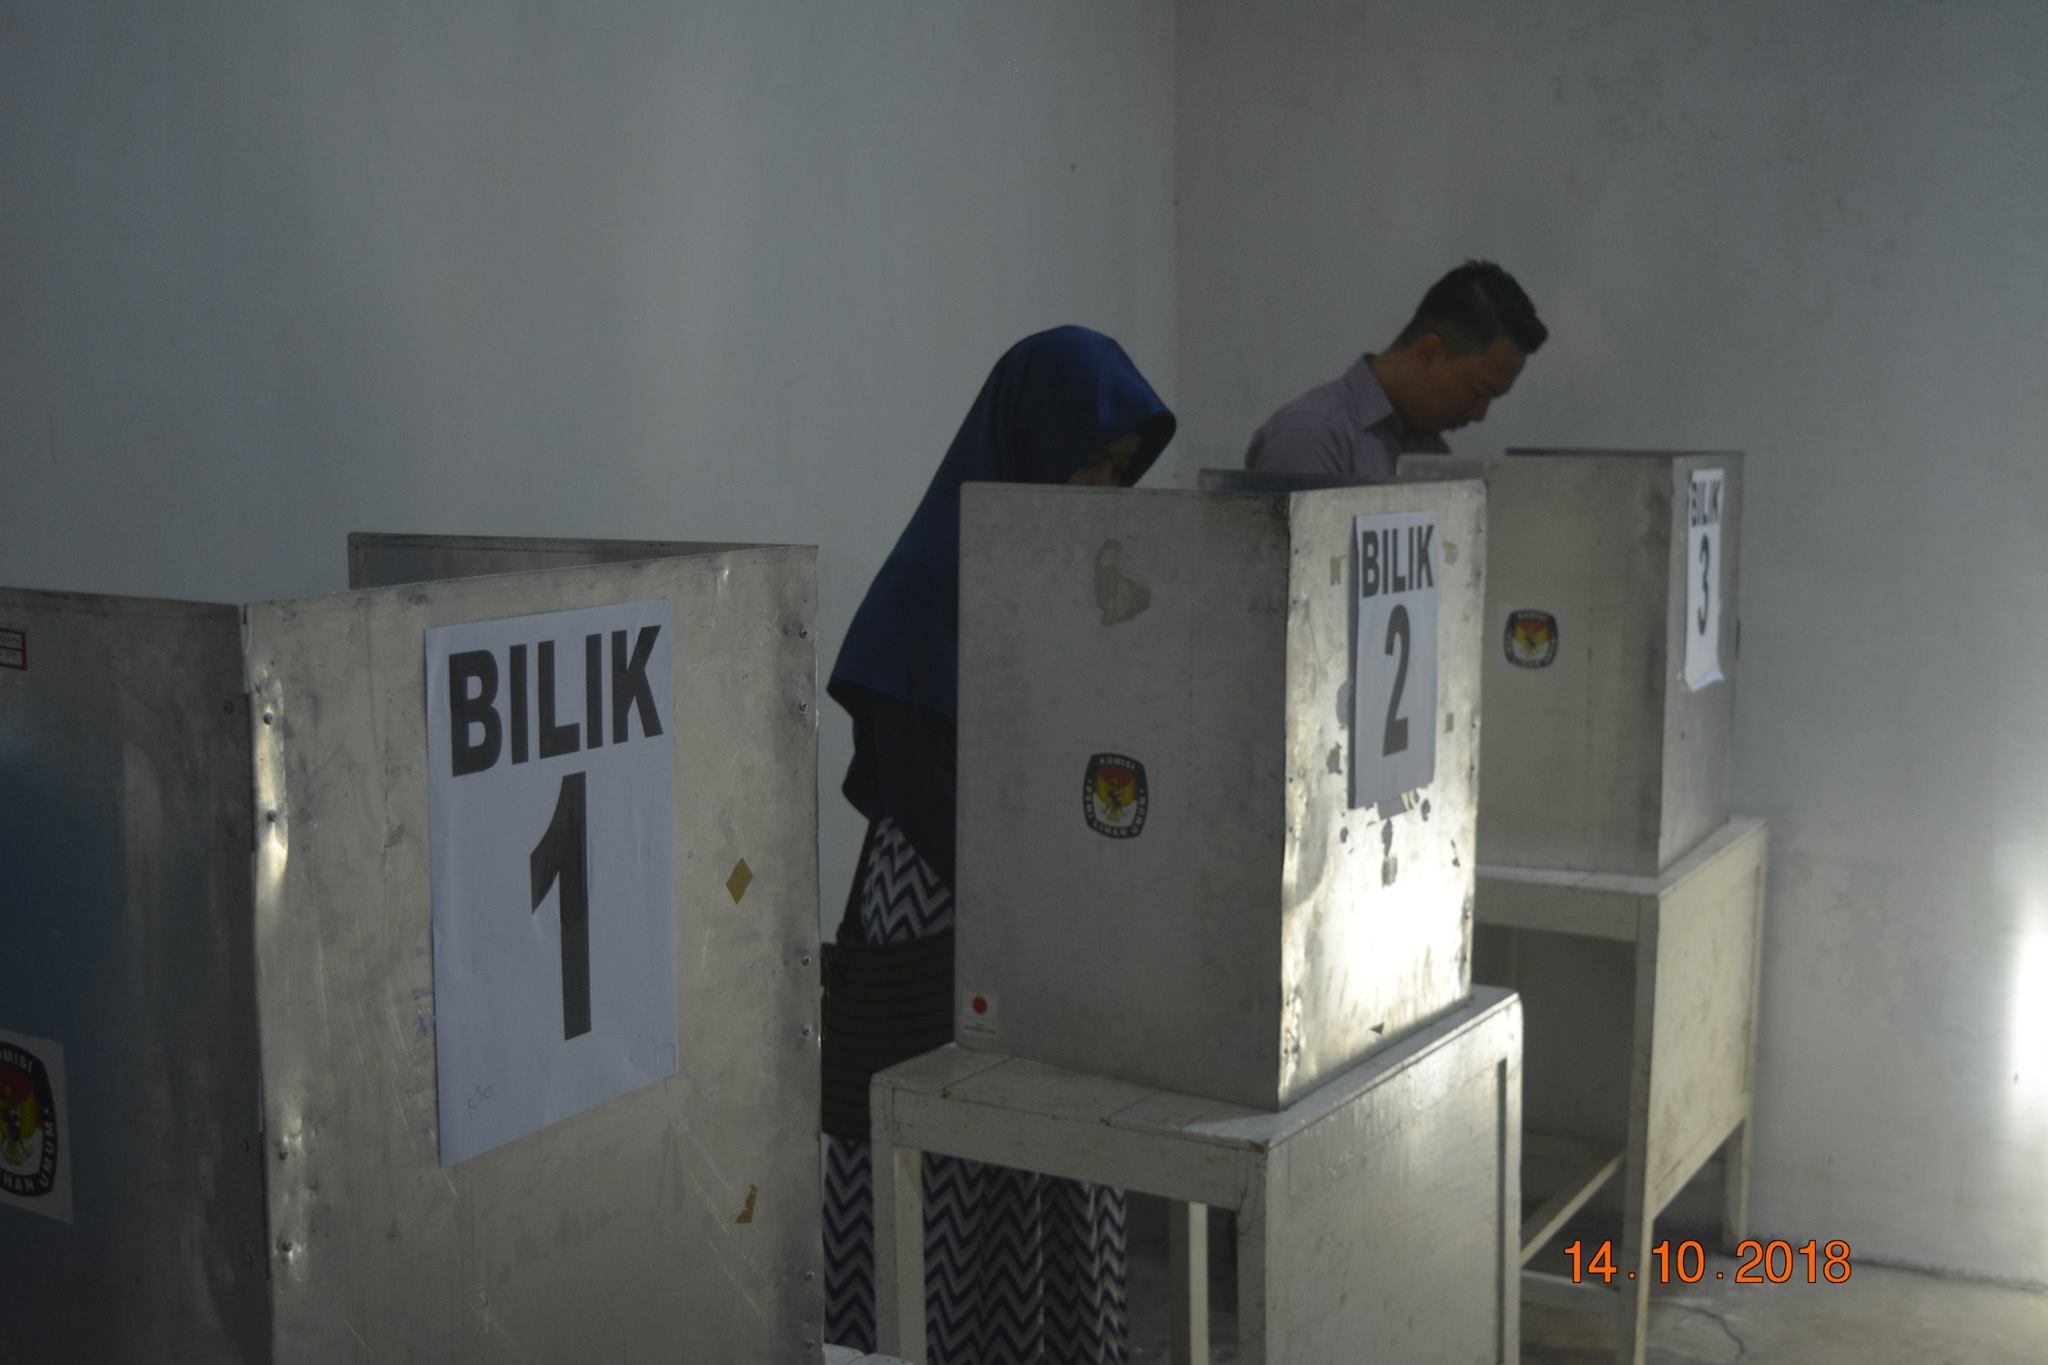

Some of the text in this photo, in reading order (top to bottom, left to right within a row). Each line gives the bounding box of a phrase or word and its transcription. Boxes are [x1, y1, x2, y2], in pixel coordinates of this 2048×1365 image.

[1362, 525, 1434, 598] BILIK
[1691, 480, 1721, 526] BILIK
[1698, 534, 1709, 634] 3
[449, 624, 663, 777] BILIK
[1382, 604, 1410, 756] 2
[530, 771, 592, 1040] 1
